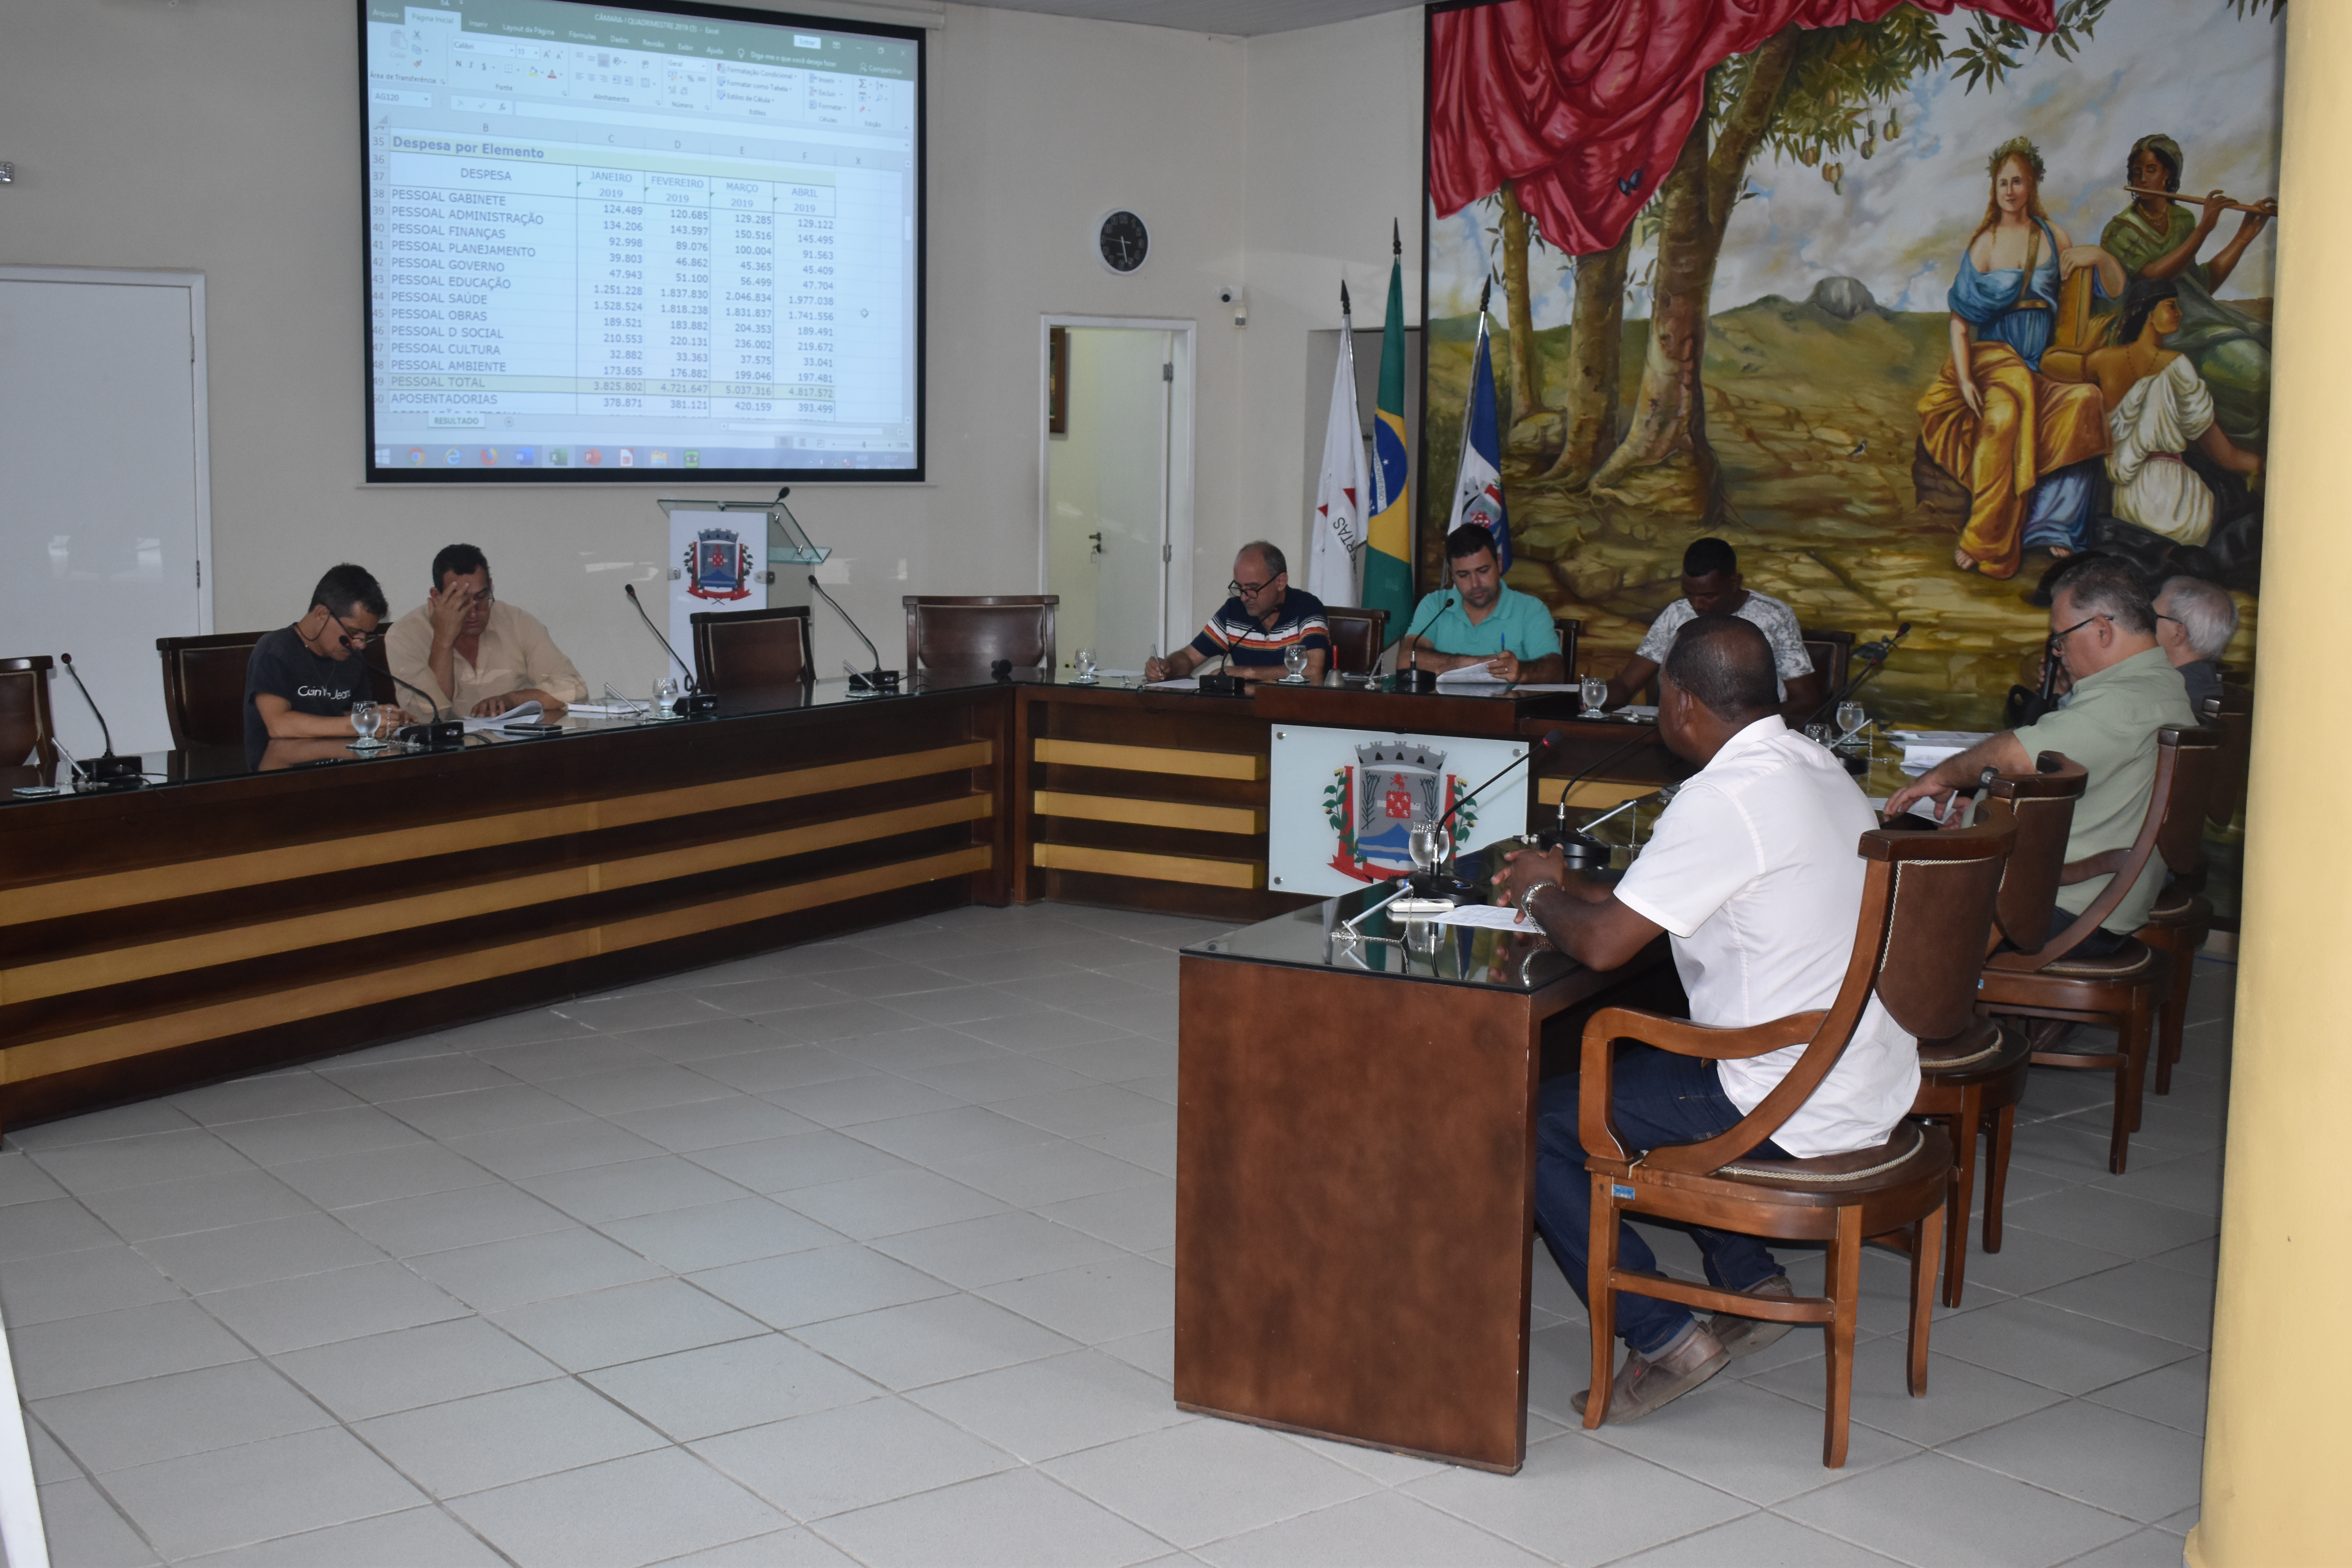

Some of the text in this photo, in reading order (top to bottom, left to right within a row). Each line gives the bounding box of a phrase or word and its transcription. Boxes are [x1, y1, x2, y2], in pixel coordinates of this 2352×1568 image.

[373, 9, 399, 18] Arquivo
[373, 137, 384, 146] 35
[393, 136, 544, 158] Despesa por Elemento
[373, 155, 384, 164] 36
[373, 172, 384, 180] 37
[461, 168, 512, 181] DESPESA
[591, 172, 632, 182] JANEIRO
[652, 176, 704, 188] FEVEREIRO
[726, 183, 759, 193] MARÇO
[373, 189, 384, 197] 38
[392, 189, 505, 205] PESSOAL GABINETE
[600, 189, 623, 197] 2019
[666, 194, 689, 202] 2019
[792, 188, 818, 197] ABRIL
[731, 198, 753, 207] 2019
[794, 203, 815, 212] 2019
[373, 206, 384, 214] 39
[392, 206, 543, 226] PESSOAL ADMINISTRAÇÃO
[604, 205, 833, 229] 124.489 120.685 129.285 129.122
[373, 223, 384, 232] 40
[392, 223, 506, 240] PESSOAL FINANÇAS
[604, 221, 833, 244] 134.206 143.597 150.516 145.495
[373, 241, 384, 249] 41
[392, 240, 535, 257] PESSOAL PLANEJAMENTO
[609, 237, 833, 260] 92.998 89.076 100.004 91.563
[373, 258, 384, 266] 42
[392, 258, 505, 272] PESSOAL GOVERNO
[610, 253, 833, 275] 39.803 46.862 45.365 45.409
[392, 274, 511, 290] PESSOAL EDUCAÇÃO
[610, 270, 833, 290] 47.943 51.100 56.499 47.704
[392, 292, 487, 304] PESSOAL SAÚDE
[595, 285, 833, 305] 1.251.228 1.837.830 2.046.834 1.977.038
[392, 309, 487, 321] PESSOAL OBRAS
[595, 301, 833, 321] 1.528.524 1.818.238 1.831.837 1.741.556
[392, 326, 444, 336] PESSOAL
[462, 328, 503, 338] SOCIAL
[604, 318, 833, 336] 189.521 183.882 204.353 189.491
[392, 343, 500, 354] PESSOAL CULTURA
[604, 334, 833, 352] 210.553 220.131 236.002 219.672
[610, 350, 833, 367] 32.882 33.363 37.575 33.041
[392, 360, 506, 372] PESSOAL AMBIENTE
[604, 366, 832, 383] 173.655 176.882 199.046 197.481
[392, 376, 485, 387] PESSOAL TOTAL
[594, 381, 833, 398] 3.825.802 4.721.647 5.037.316 4.817.572
[391, 394, 497, 404] APOSENTADORIAS
[604, 398, 833, 413] 378.871 381.121 420.159 393.499
